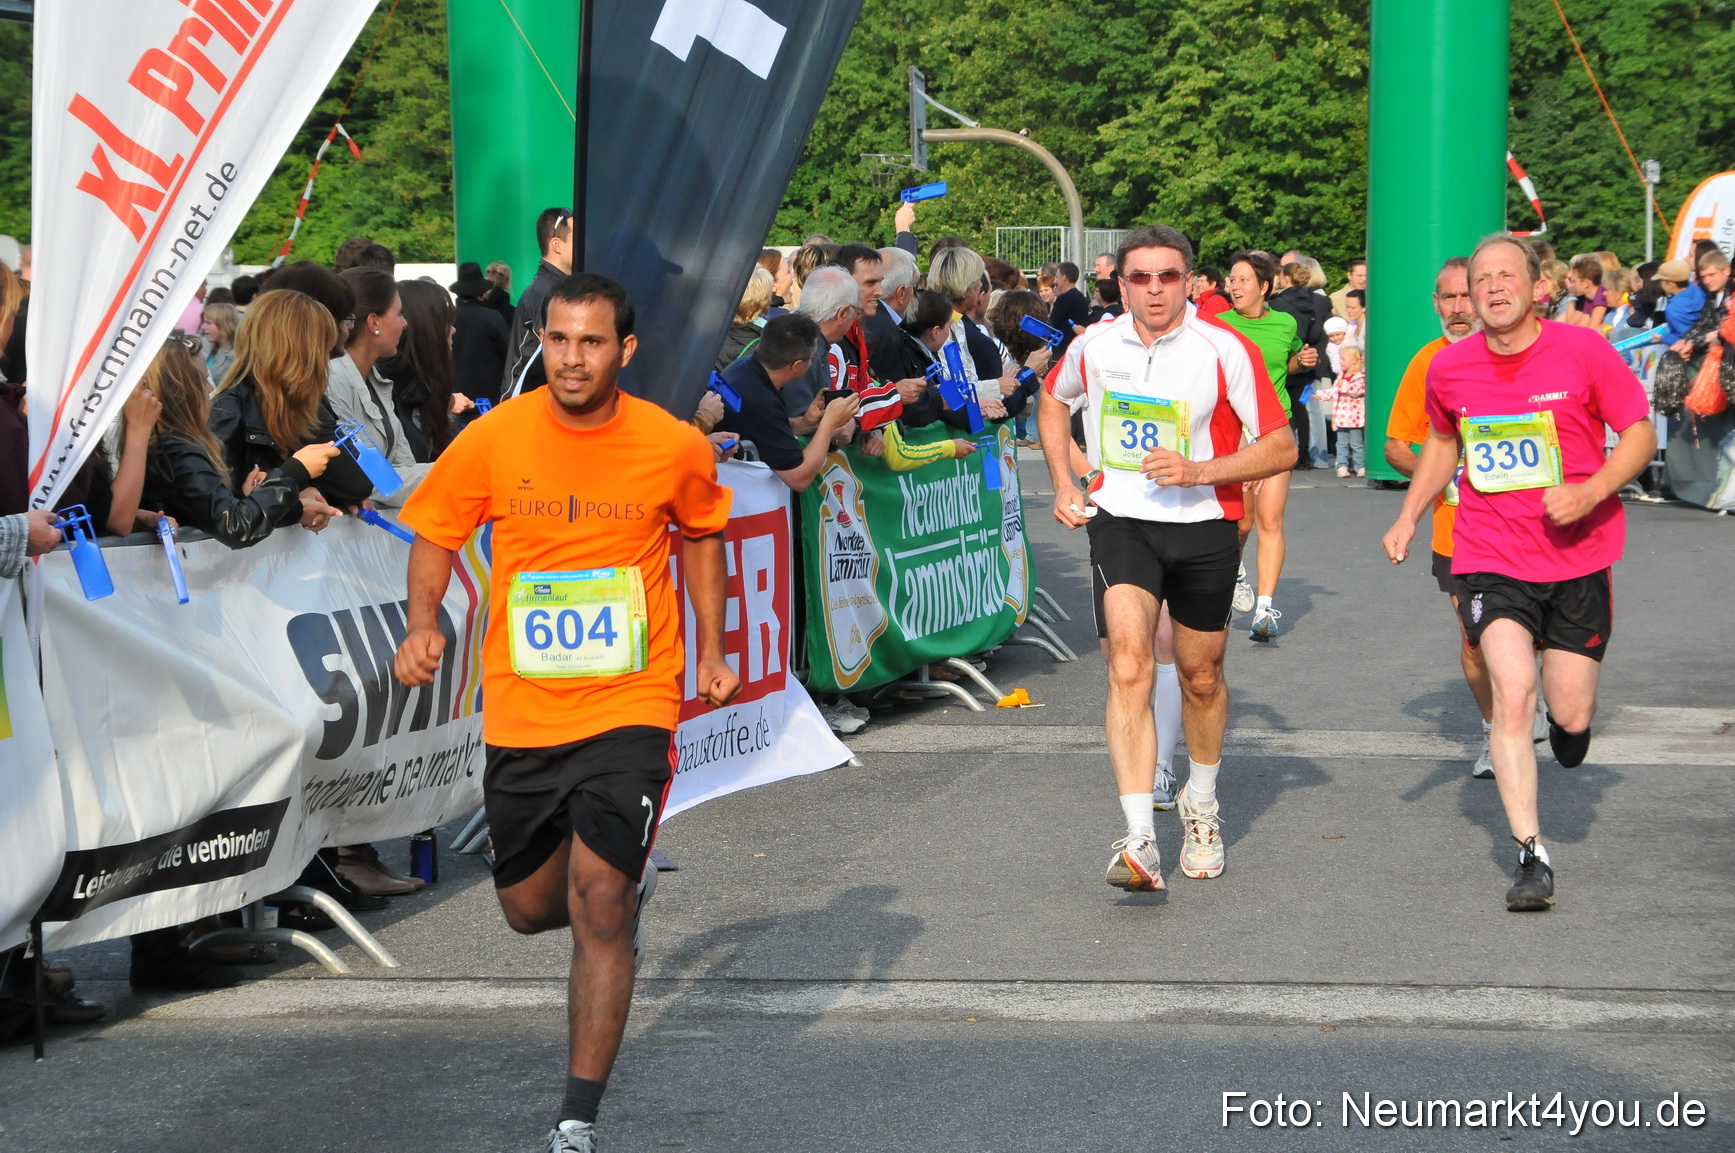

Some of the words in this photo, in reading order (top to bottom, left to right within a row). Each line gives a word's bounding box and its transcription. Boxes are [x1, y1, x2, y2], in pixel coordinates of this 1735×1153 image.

[67, 92, 185, 244] XL
[1120, 419, 1158, 452] 38
[1122, 450, 1142, 459] Josef
[1474, 438, 1539, 473] 330
[1484, 472, 1509, 481] Edwin
[509, 498, 563, 518] EURO
[585, 501, 645, 521] POLES
[897, 459, 983, 540] Neumarkter
[885, 528, 1006, 642] Lammsbräu
[525, 605, 618, 651] 604
[541, 652, 573, 662] Badar
[302, 756, 397, 816] tadtwerke
[186, 828, 271, 865] verbinden
